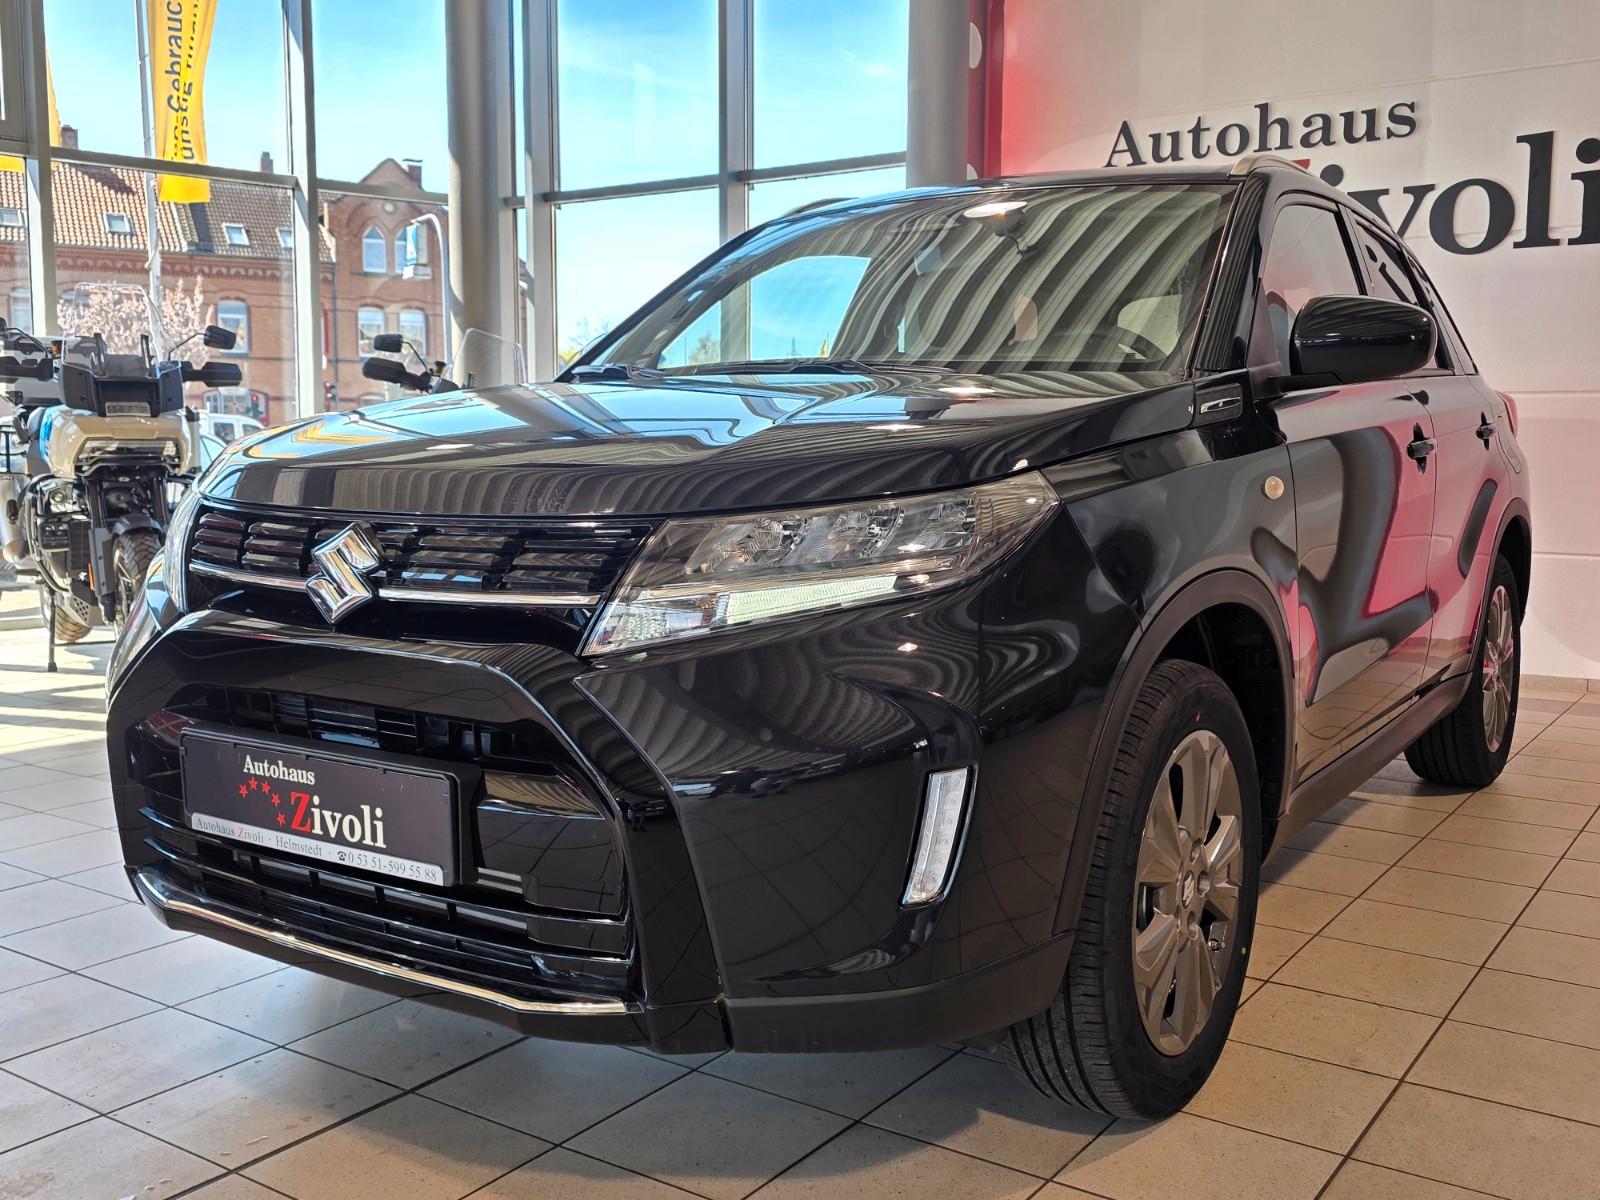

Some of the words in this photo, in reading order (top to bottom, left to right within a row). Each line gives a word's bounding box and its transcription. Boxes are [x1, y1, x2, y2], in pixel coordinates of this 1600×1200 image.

[1104, 100, 1418, 168] Autohaus
[243, 754, 316, 786] Autohaus
[196, 818, 236, 837] Autohaus
[237, 826, 264, 843] Zivoli
[275, 835, 323, 857] Helmstedt
[290, 791, 387, 848] Zivoli
